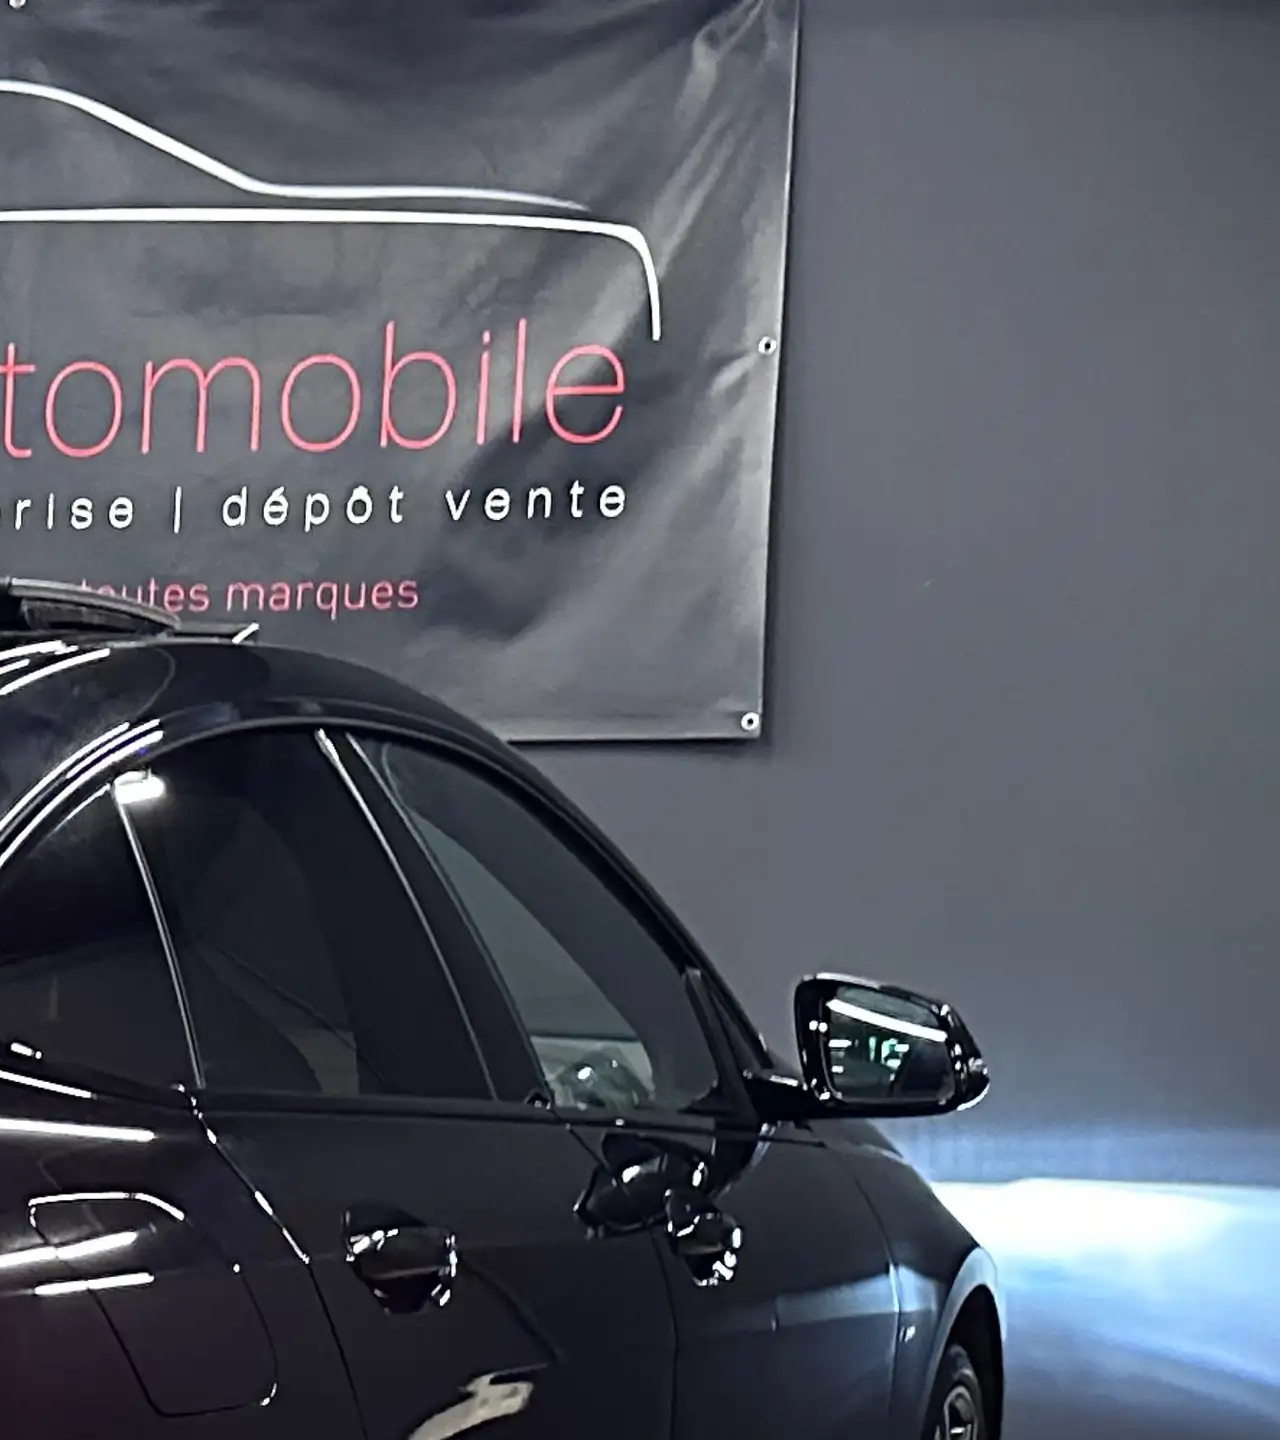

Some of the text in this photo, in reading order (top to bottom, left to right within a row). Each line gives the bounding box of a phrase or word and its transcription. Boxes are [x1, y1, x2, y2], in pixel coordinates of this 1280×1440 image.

[221, 485, 406, 532] dépôt
[443, 480, 627, 522] vente
[225, 578, 420, 621] marques
